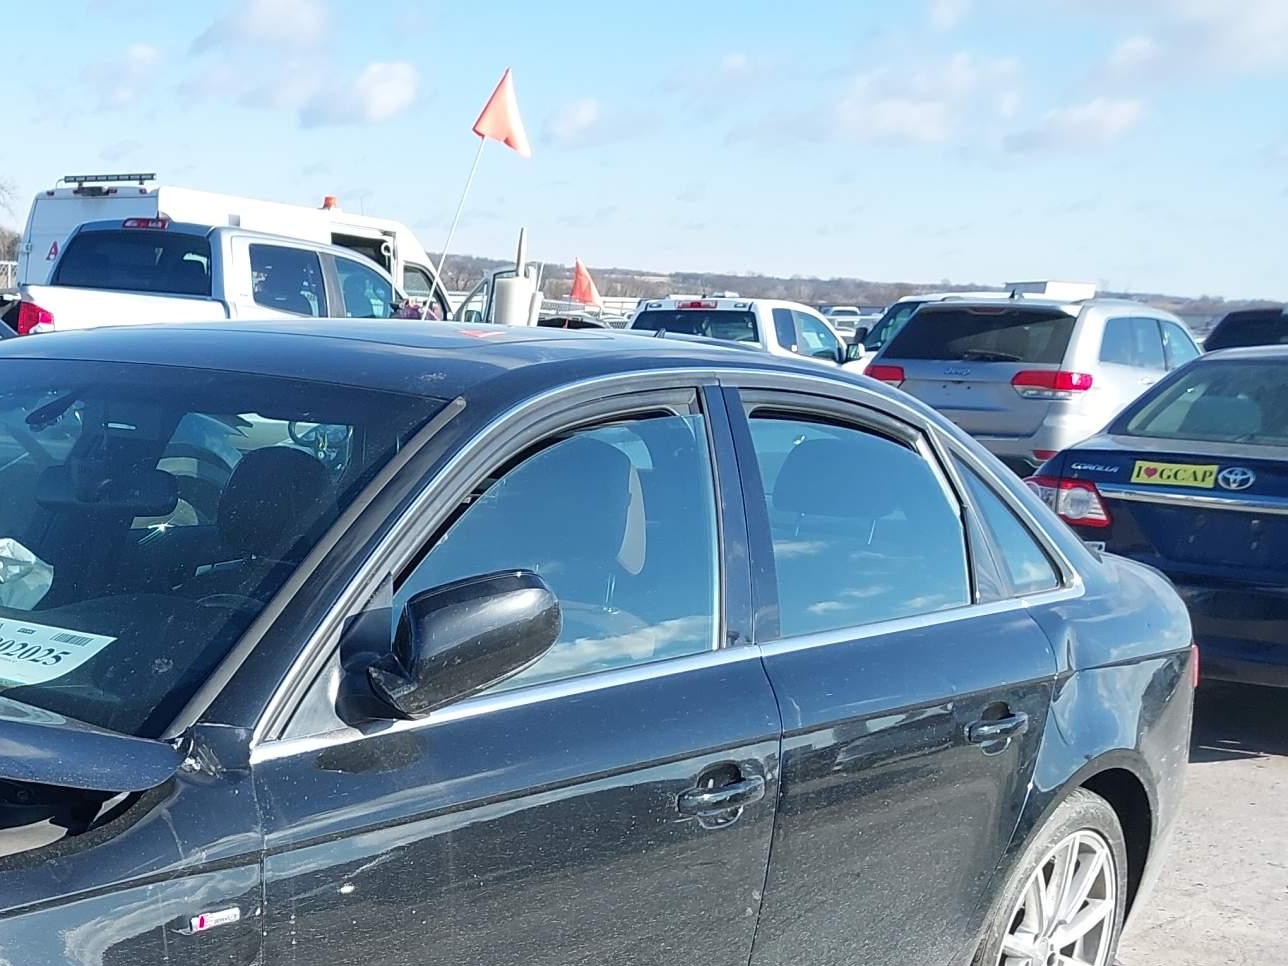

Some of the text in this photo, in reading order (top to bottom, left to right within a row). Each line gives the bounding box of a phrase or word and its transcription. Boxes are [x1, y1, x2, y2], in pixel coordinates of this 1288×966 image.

[1071, 462, 1120, 473] COROLLA
[1135, 465, 1214, 483] I GCAP
